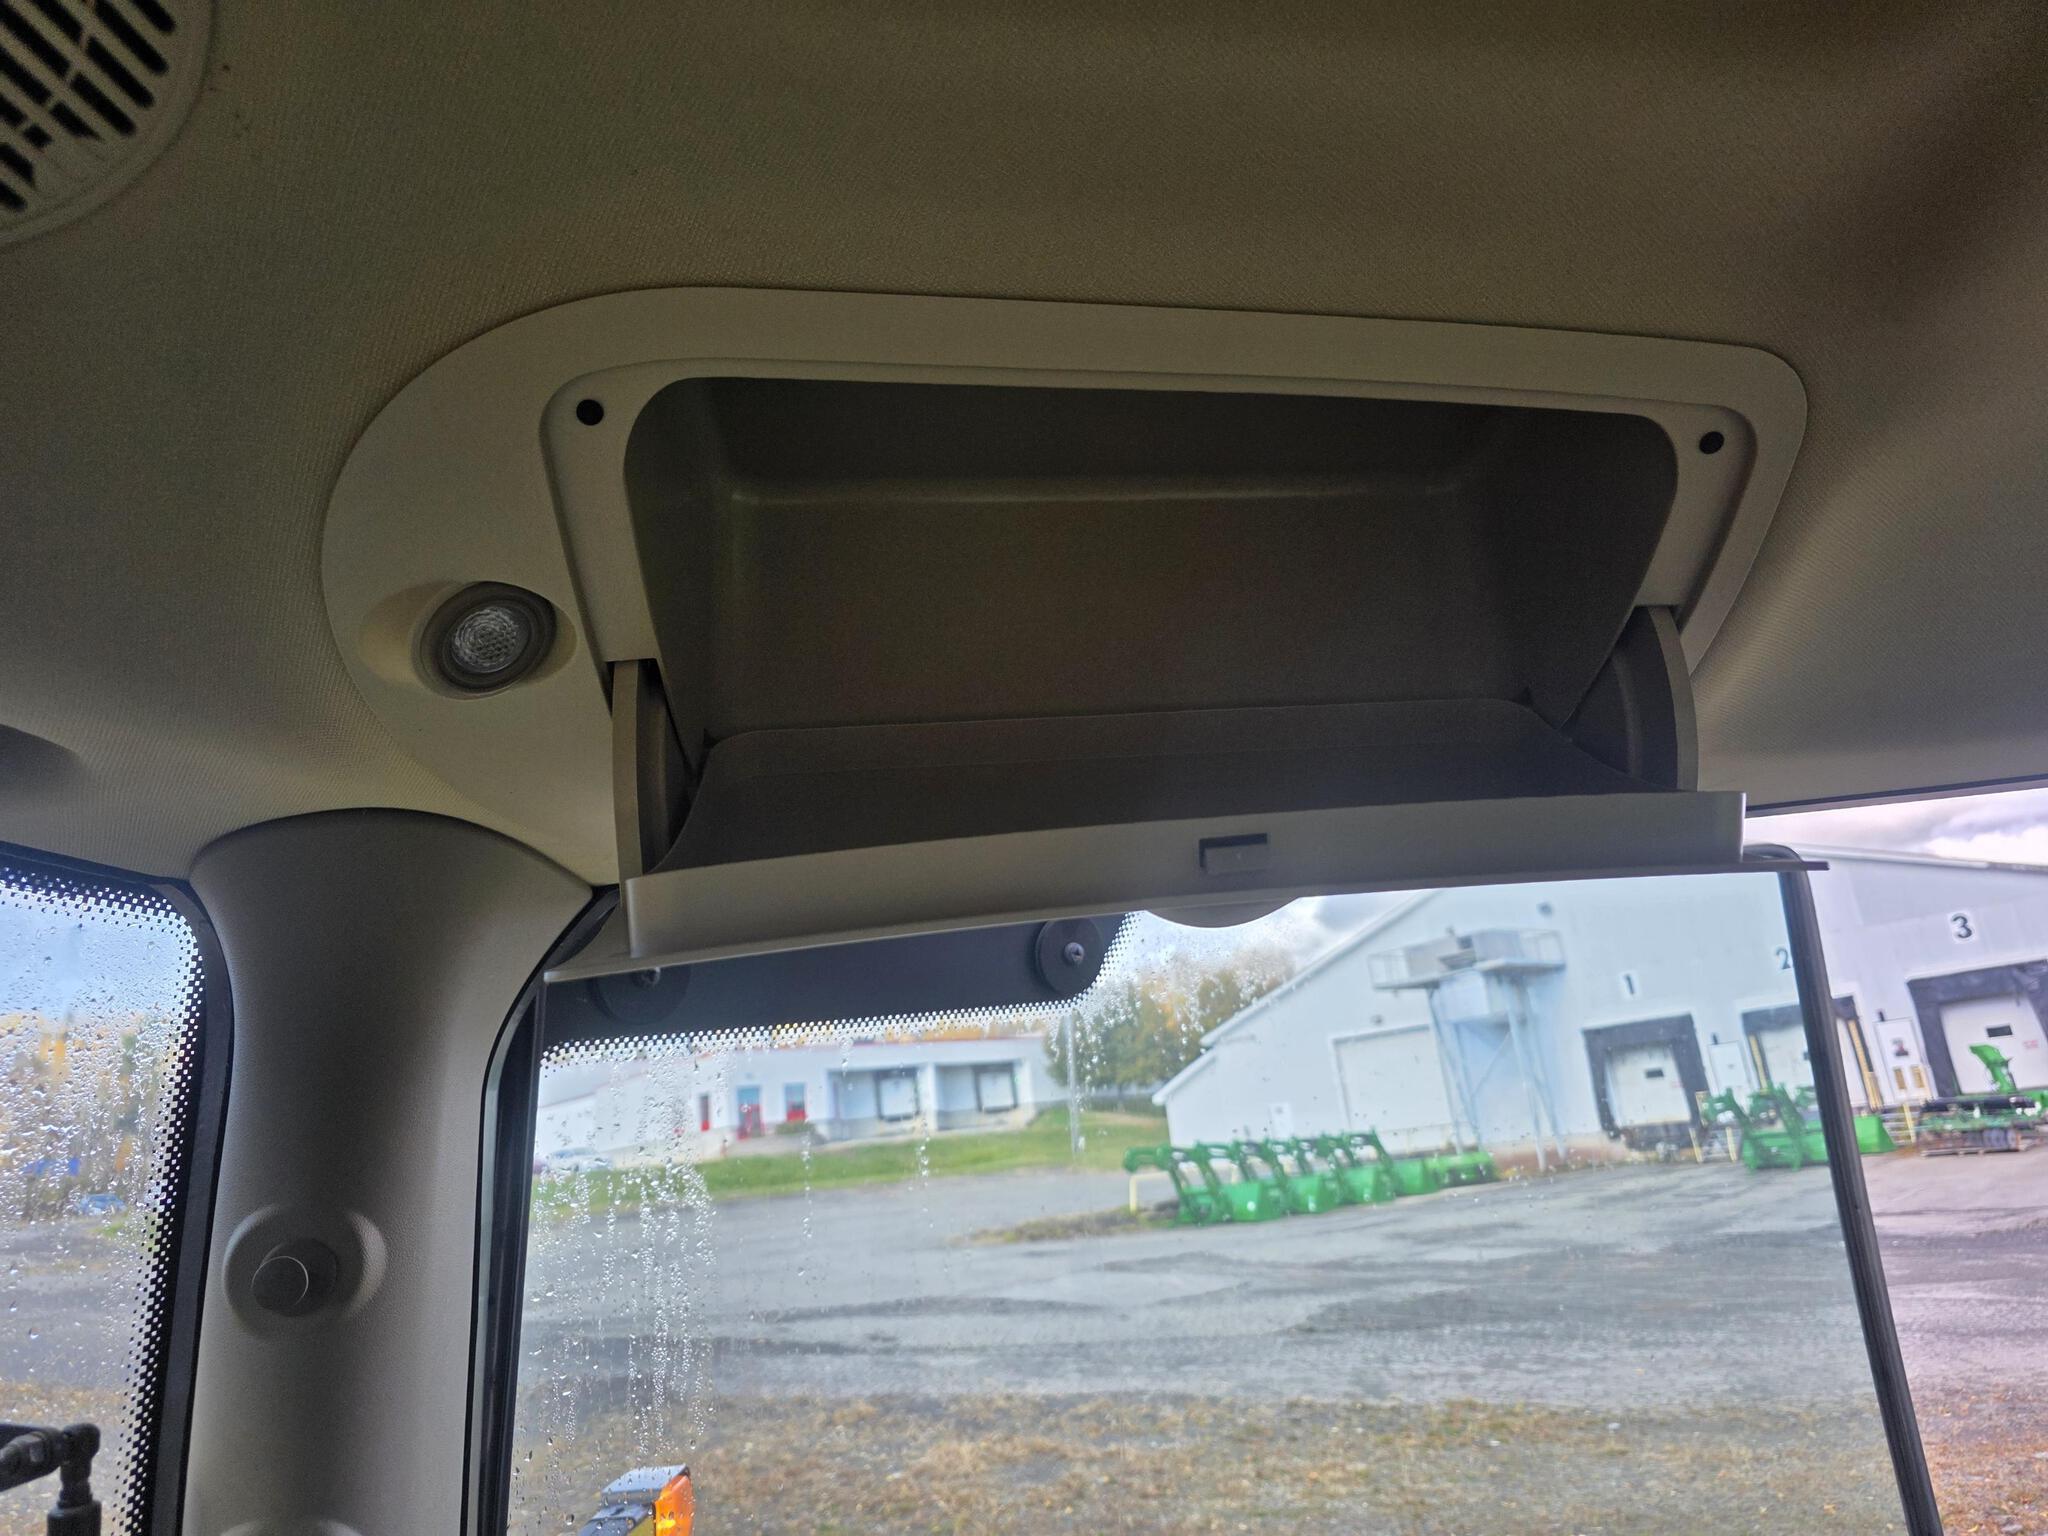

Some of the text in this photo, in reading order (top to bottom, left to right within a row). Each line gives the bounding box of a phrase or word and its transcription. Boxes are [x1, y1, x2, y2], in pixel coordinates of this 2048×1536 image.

[1952, 914, 1973, 939] 3
[1775, 947, 1792, 970] 2
[1624, 973, 1636, 995] 1
